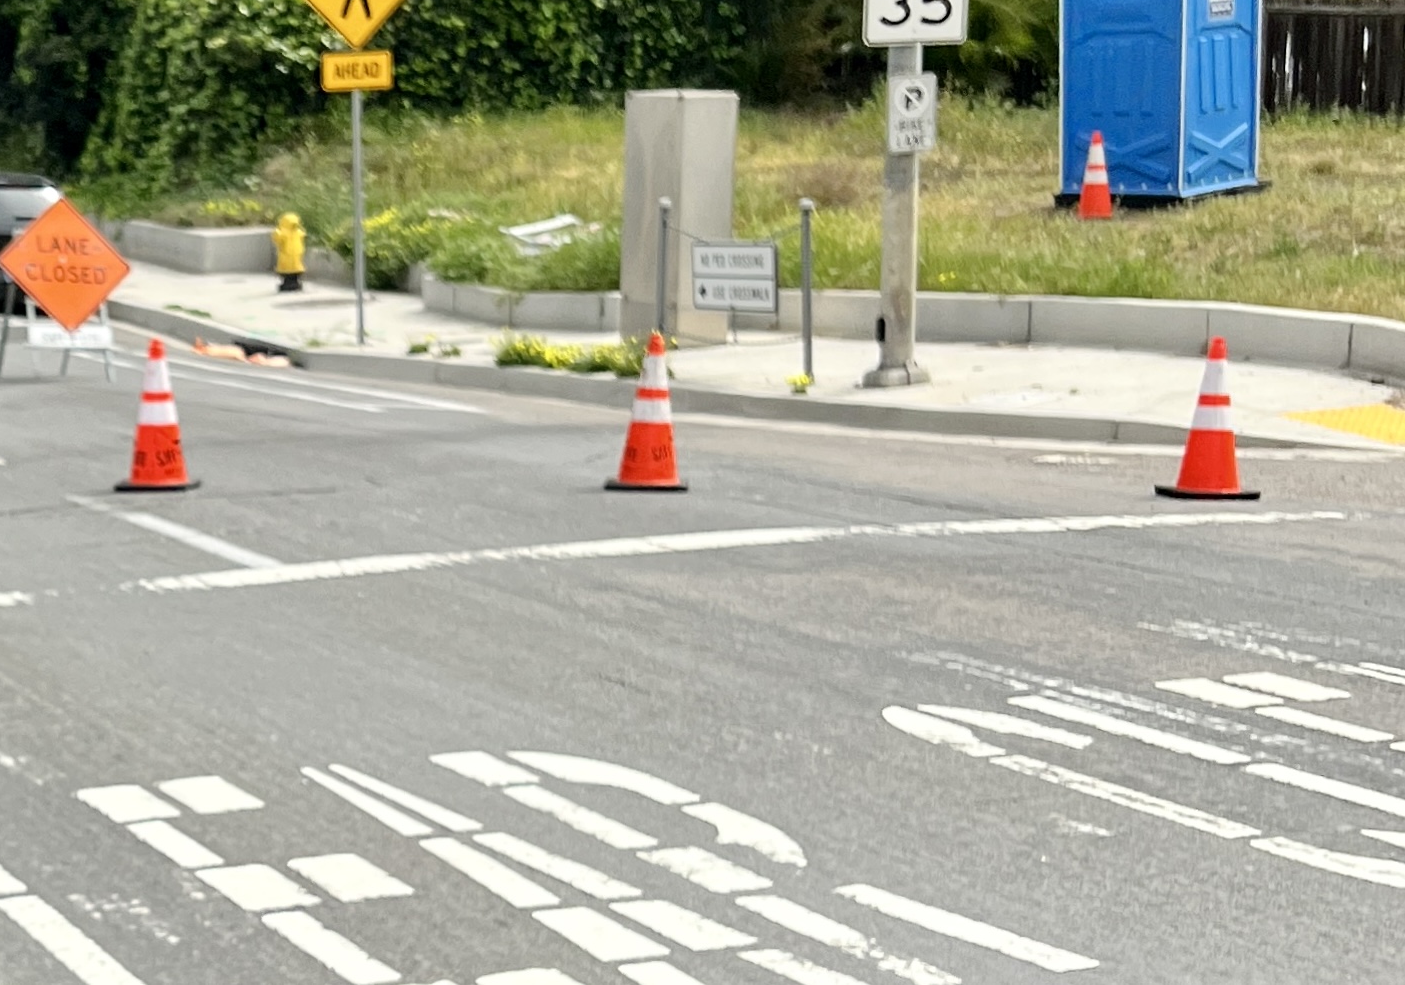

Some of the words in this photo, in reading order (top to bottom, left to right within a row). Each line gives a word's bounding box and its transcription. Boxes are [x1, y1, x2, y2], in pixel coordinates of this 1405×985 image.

[333, 62, 380, 80] AHEAD
[35, 236, 91, 258] LANE
[24, 263, 107, 287] CLOSED
